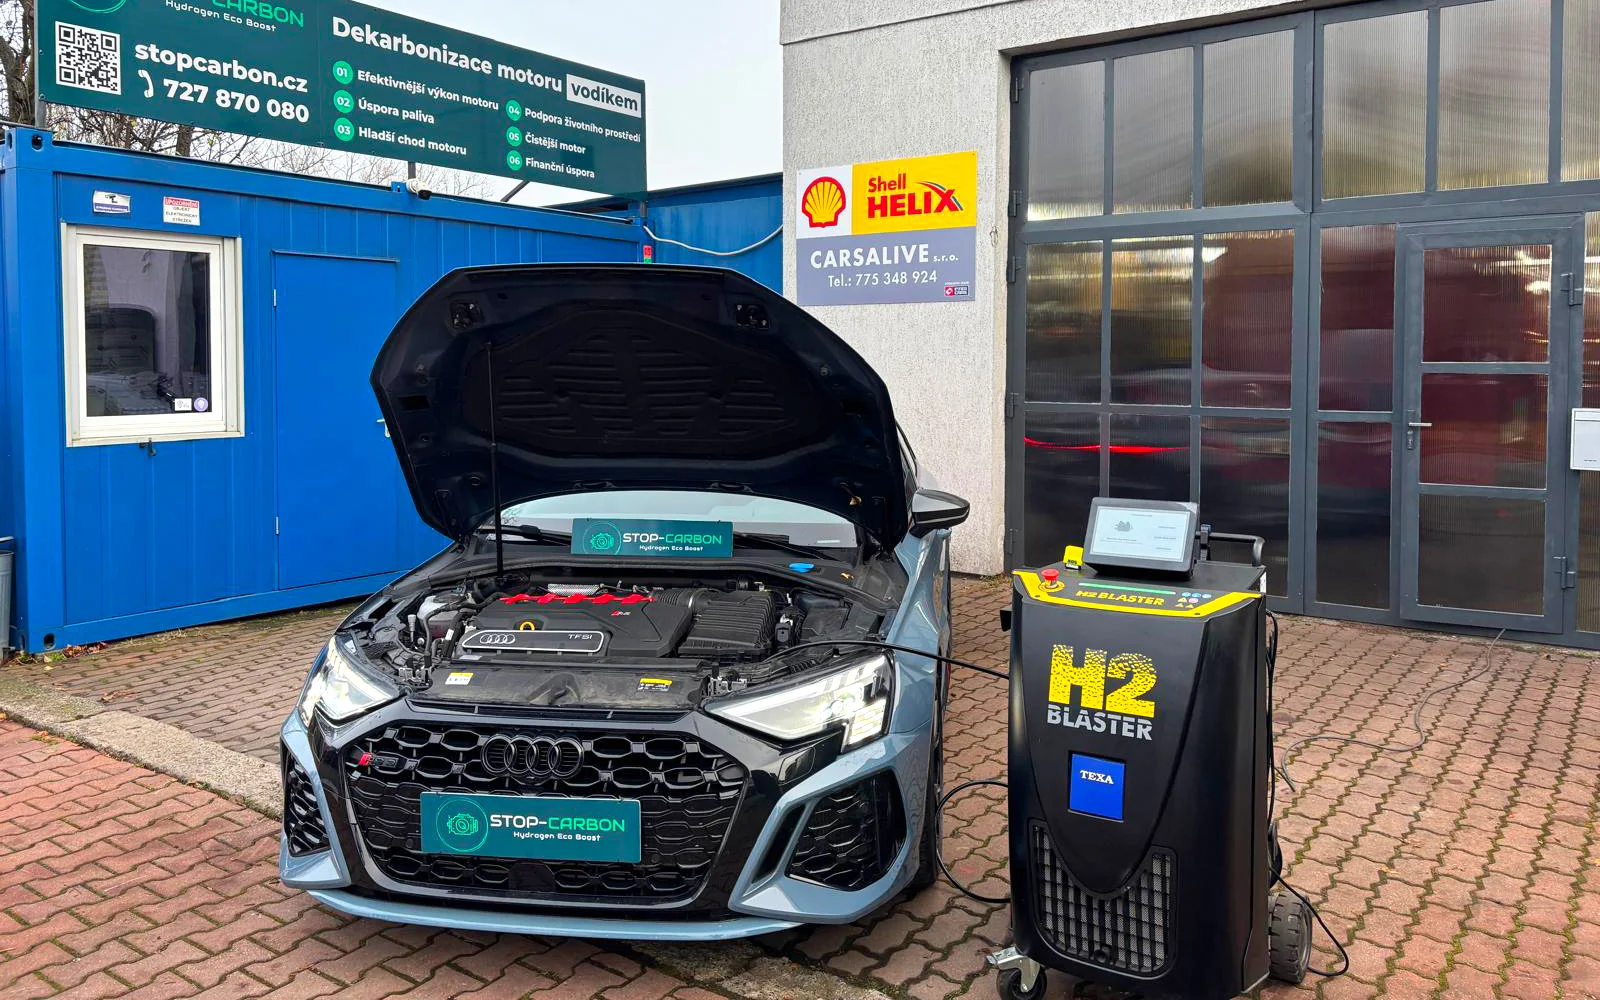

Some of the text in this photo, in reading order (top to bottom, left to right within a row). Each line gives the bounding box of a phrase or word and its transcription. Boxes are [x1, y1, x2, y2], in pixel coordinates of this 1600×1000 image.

[165, 0, 277, 32] Hydrogen Eco Boost
[135, 43, 309, 93] stopcarbon.cz
[332, 16, 638, 111] Dekarbonizace motoru vodíkem
[163, 78, 310, 123] 727 870 080
[336, 66, 499, 110] 01 Efektivnější výkon motoru
[336, 96, 435, 125] 02 Úspora paliva
[508, 105, 641, 143] 04 Podpora životního prostředí
[337, 124, 467, 155] 03 Hladší chod motoru
[508, 130, 586, 155] 05 Čistější motor
[509, 155, 595, 179] 06 Finanční úspora
[868, 173, 907, 193] Shell
[867, 186, 961, 219] HELIX
[810, 243, 959, 269] CARSALIVE s.r.o.
[828, 270, 938, 288] Tel.: 775 348 924
[623, 533, 722, 545] STOP-CARBON
[639, 544, 670, 552] Hydrogen
[1048, 644, 1157, 718] H2
[1047, 704, 1152, 741] BLASTER
[1080, 769, 1115, 785] TEXA
[490, 815, 626, 832] STOP-CARBON
[513, 831, 602, 842] Hydrogen Eco Boost
